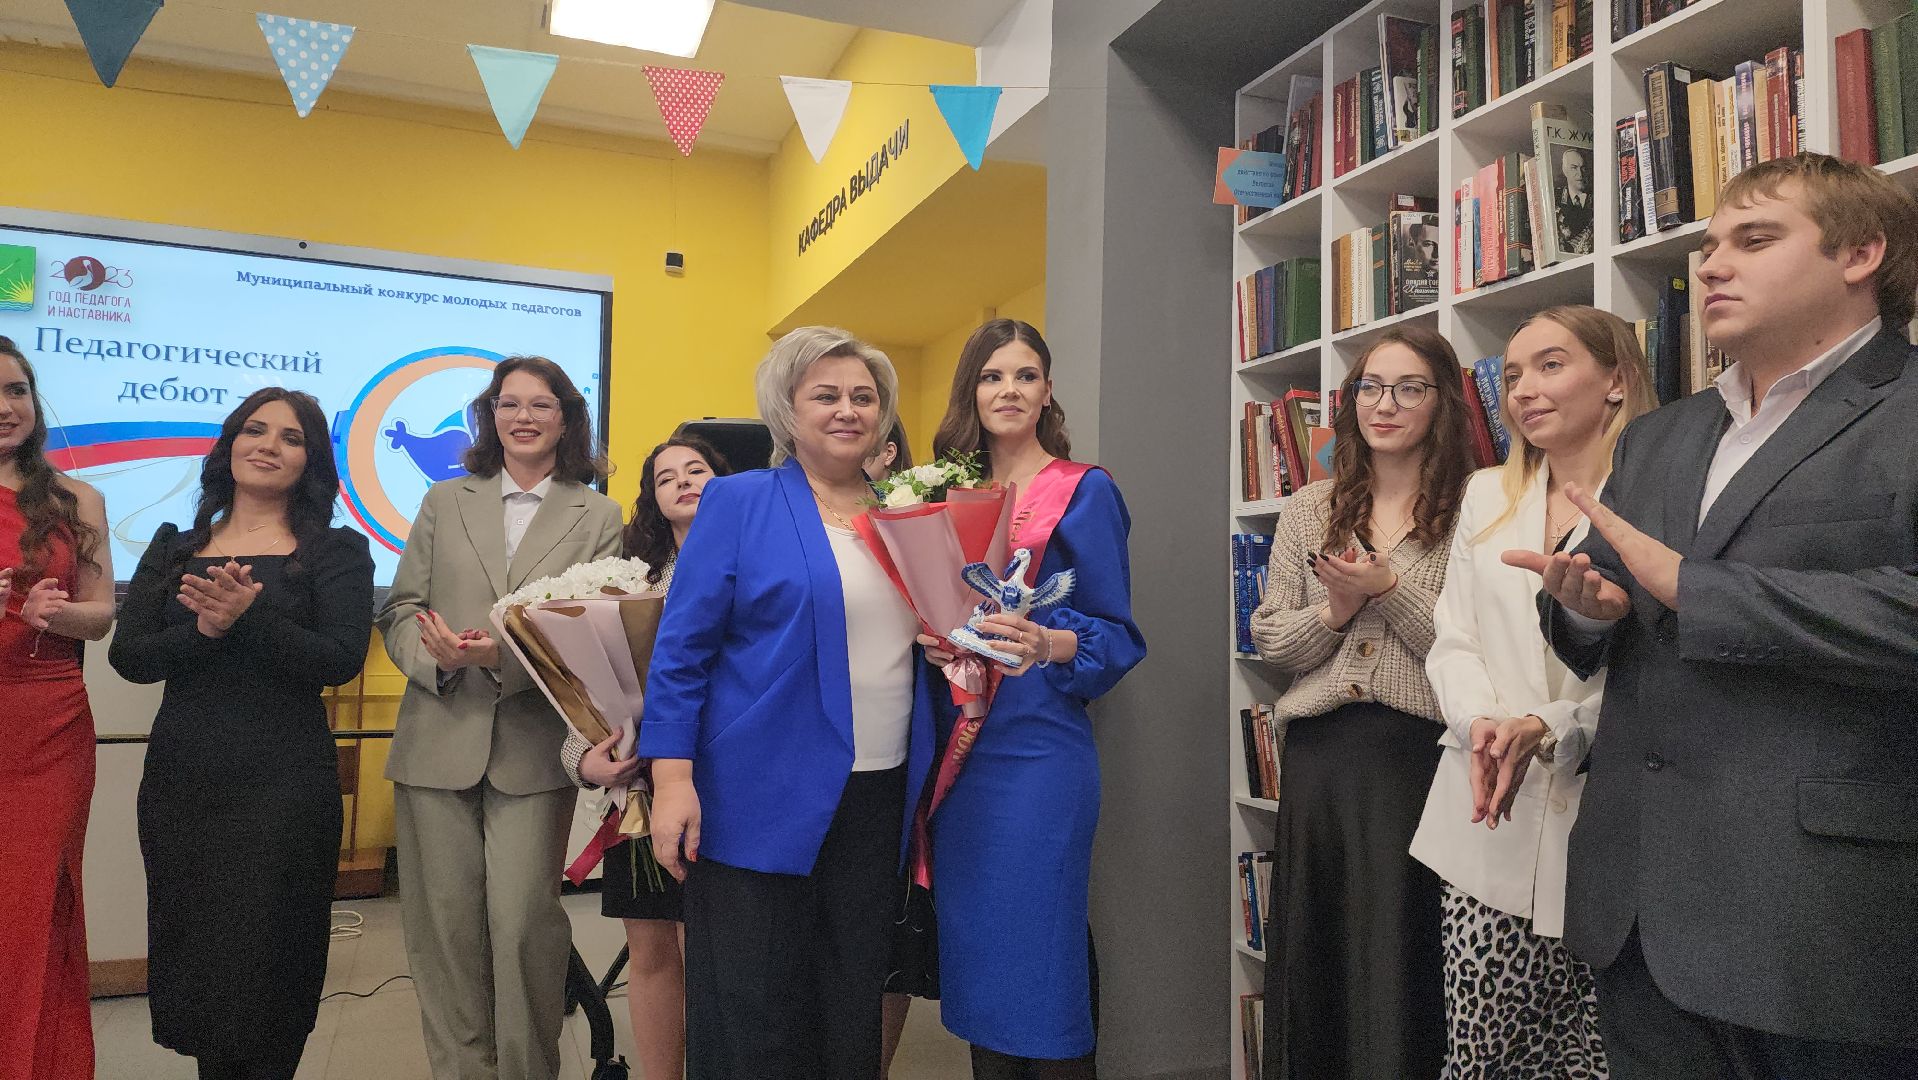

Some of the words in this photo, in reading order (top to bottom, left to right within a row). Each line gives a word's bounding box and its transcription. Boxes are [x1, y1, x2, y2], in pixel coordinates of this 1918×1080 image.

[1568, 128, 1593, 143] ЖУК
[799, 187, 847, 257] КАФЕДРА
[850, 118, 909, 204] ВЫДАЧИ
[48, 290, 71, 304] ГОД
[74, 292, 131, 308] ПЕДАГОГА
[236, 270, 373, 296] Муниципальный
[377, 287, 439, 304] конкурс
[443, 294, 507, 309] молодых
[511, 302, 582, 317] педагогов
[47, 306, 56, 317] И
[58, 306, 131, 324] НАСТАВНИКА
[34, 326, 323, 374] Педагогический
[117, 376, 228, 405] дебют
